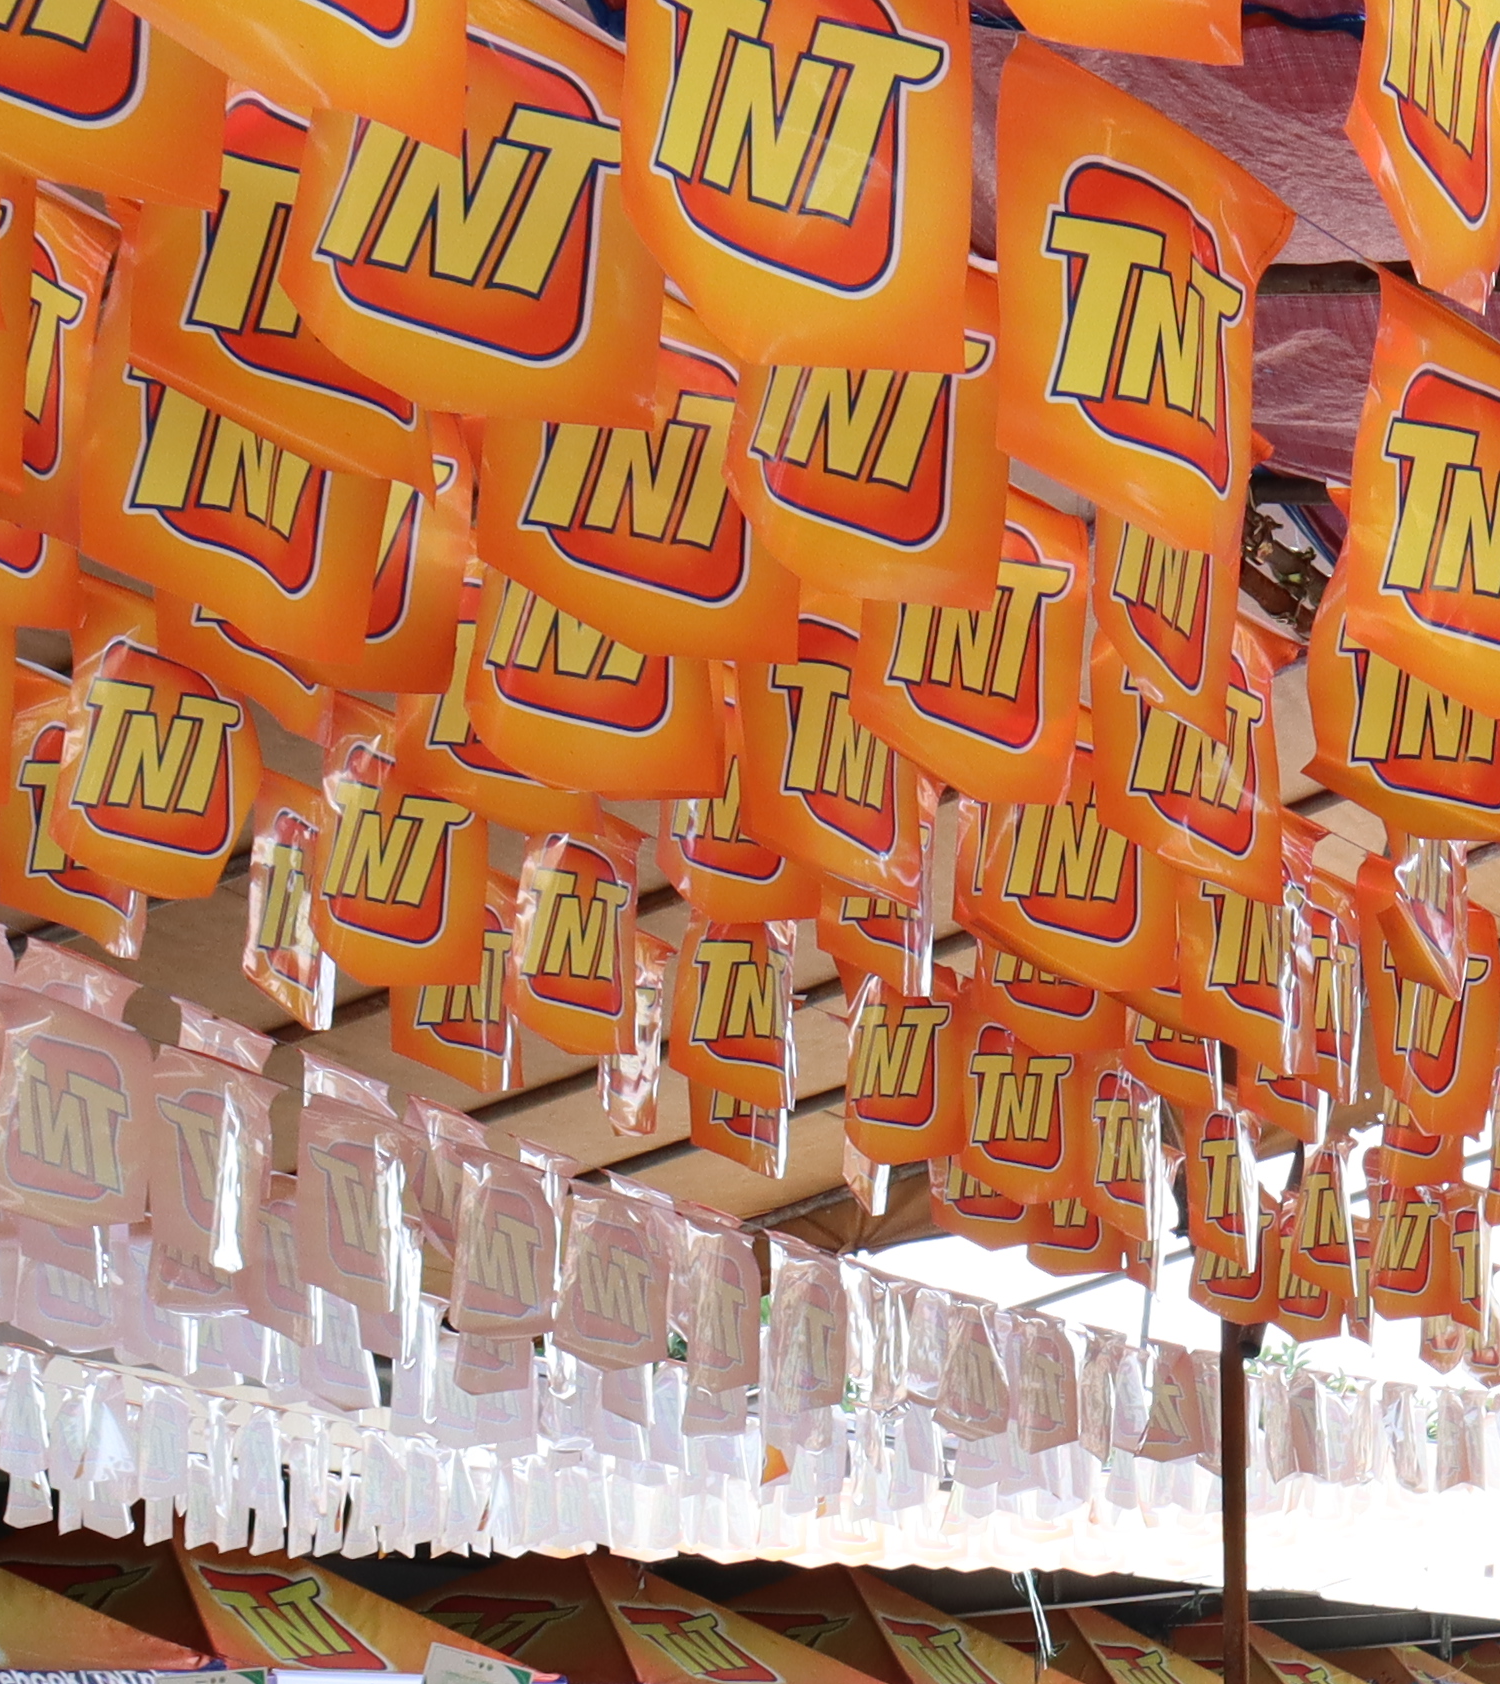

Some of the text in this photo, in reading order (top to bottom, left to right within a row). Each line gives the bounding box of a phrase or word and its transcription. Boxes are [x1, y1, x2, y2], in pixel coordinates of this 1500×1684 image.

[1052, 214, 1244, 431] TNT
[72, 684, 244, 813] TNT
[322, 781, 474, 906] TNT
[522, 871, 630, 985] TNT
[852, 1003, 951, 1107] TNT
[971, 1052, 1073, 1148] TNT
[206, 1578, 358, 1662] TNT
[632, 1611, 752, 1676] TNT
